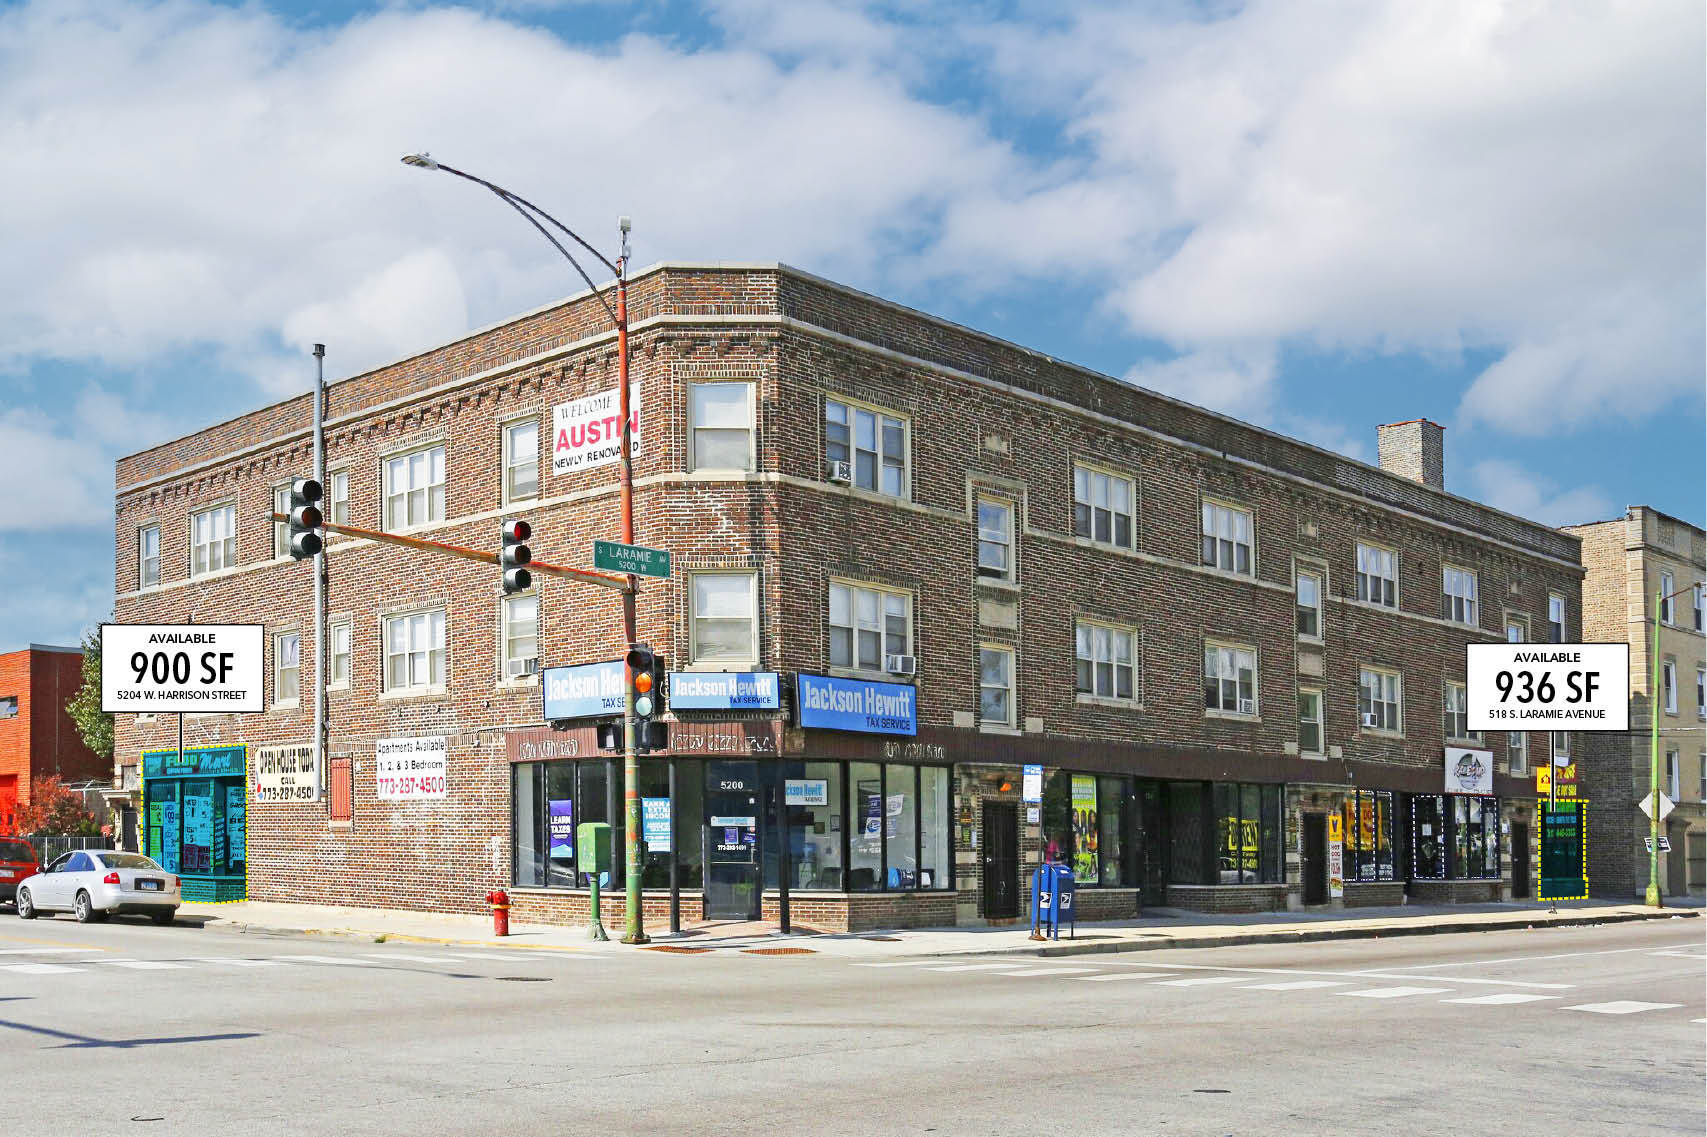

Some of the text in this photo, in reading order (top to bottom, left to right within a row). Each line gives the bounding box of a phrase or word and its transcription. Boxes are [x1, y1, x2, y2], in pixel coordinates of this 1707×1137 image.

[561, 395, 614, 420] WELCOME
[554, 441, 639, 470] NEWLY RENOVAD
[598, 546, 603, 554] S
[609, 546, 653, 563] LARAMIE
[618, 560, 647, 572] 5200 W
[547, 670, 600, 701] Jackson
[675, 678, 772, 697] Jackson Hewitt
[602, 697, 616, 709] TAX
[730, 695, 772, 704] TAX SERVICE
[804, 681, 910, 718] Jackson Hewitt
[866, 716, 911, 731] TAX SERVICE
[378, 739, 444, 756] Apartments Available
[260, 747, 315, 775] OPEN HOUSE TODA
[404, 760, 409, 770] 3
[411, 760, 443, 770] Bedroom
[280, 776, 296, 785] CALL
[379, 776, 445, 794] 773-287-4500
[720, 780, 744, 790] 5200
[550, 815, 571, 825] LEARN
